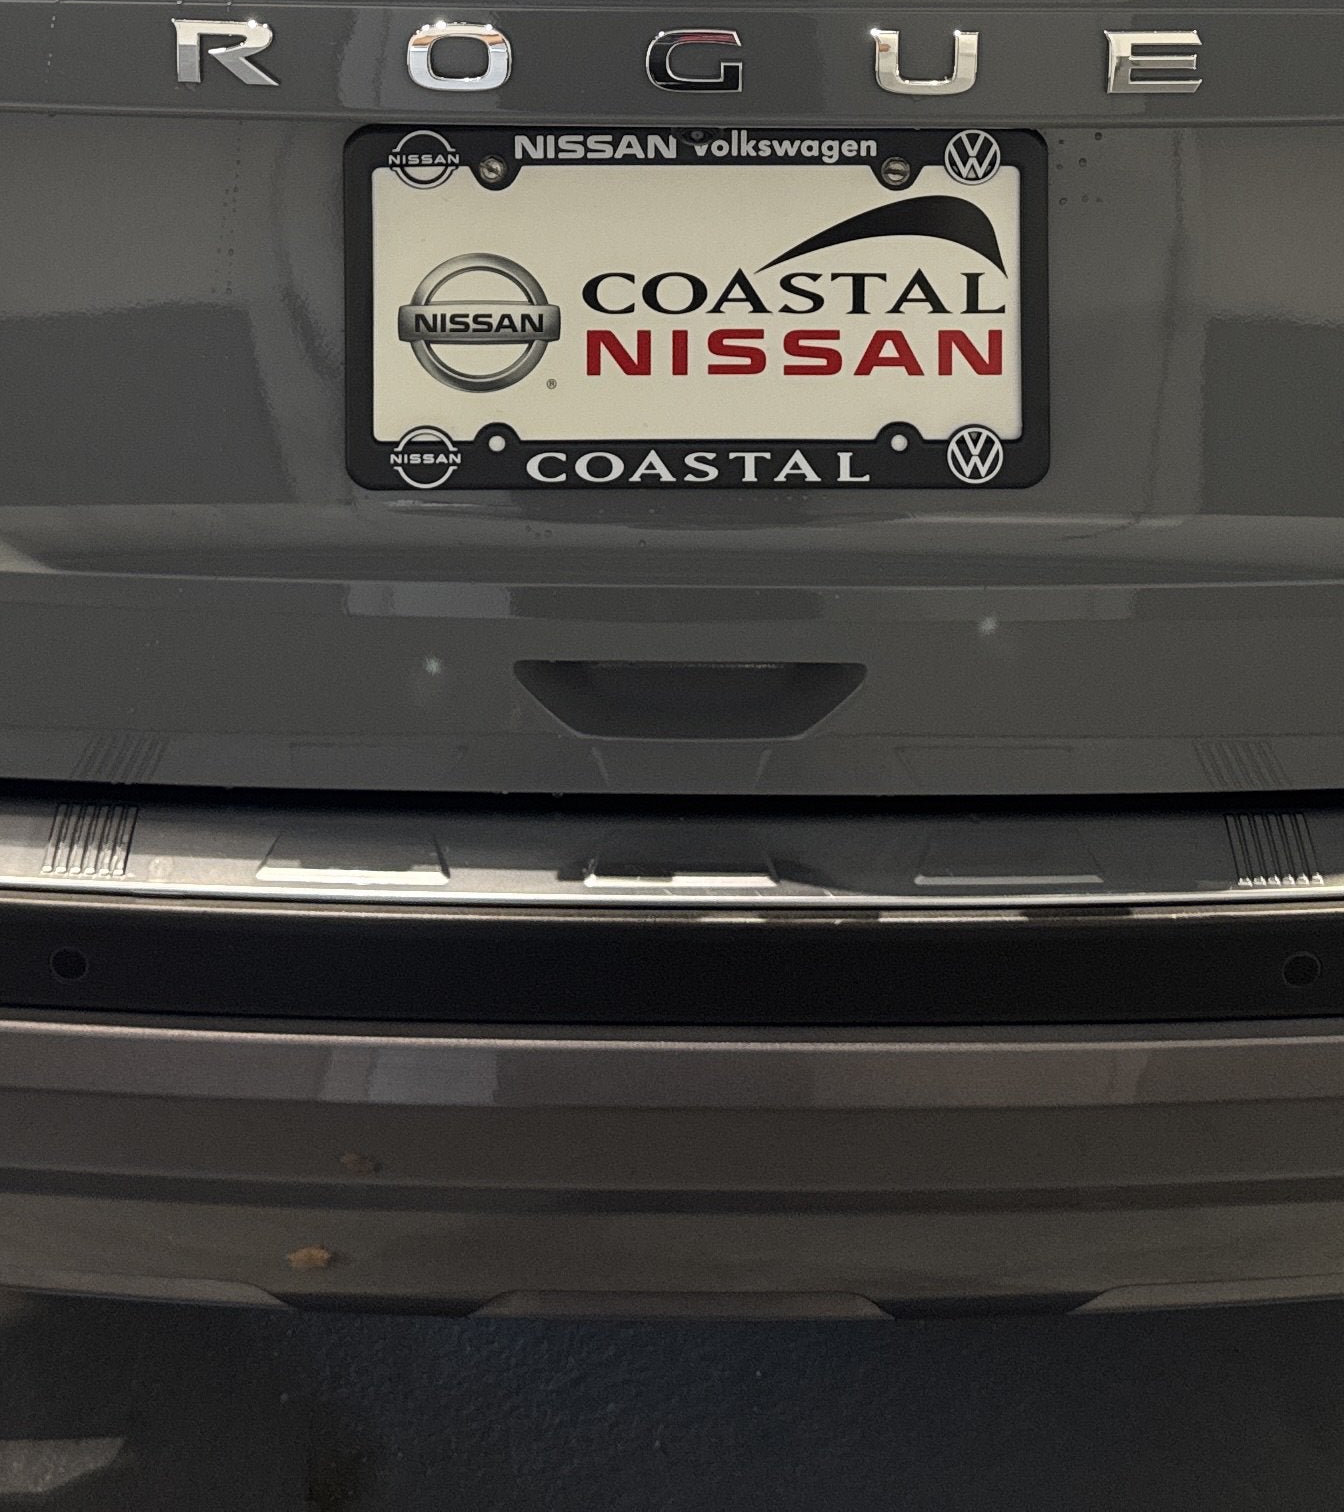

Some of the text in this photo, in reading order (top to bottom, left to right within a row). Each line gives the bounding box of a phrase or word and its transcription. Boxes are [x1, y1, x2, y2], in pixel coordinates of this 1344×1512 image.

[172, 19, 1203, 95] ROGUE
[388, 153, 461, 166] NISSAN
[514, 134, 677, 160] NISSAN
[581, 267, 1007, 315] COASTAL
[414, 313, 545, 334] NISSAN
[585, 328, 1004, 377] NISSAN
[389, 453, 462, 465] NISSAN
[525, 449, 871, 483] COASTAL
